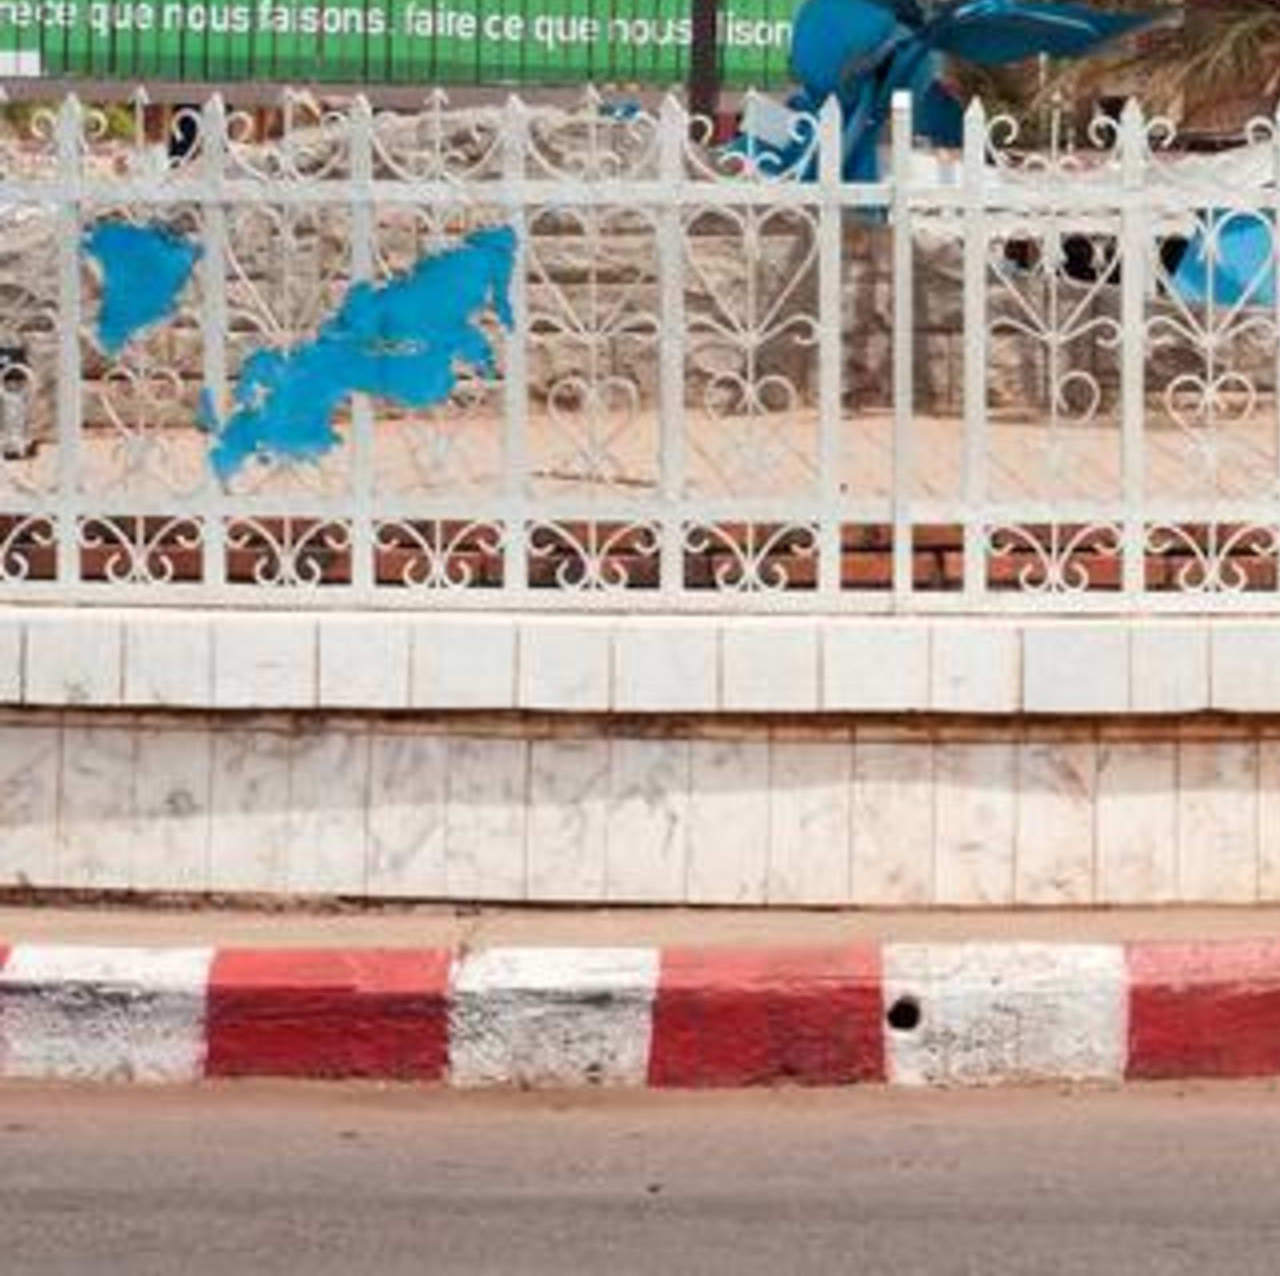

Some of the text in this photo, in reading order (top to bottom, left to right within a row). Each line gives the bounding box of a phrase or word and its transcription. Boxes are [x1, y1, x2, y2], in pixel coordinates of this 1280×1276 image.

[90, 2, 154, 37] que
[162, 3, 250, 32] nous
[406, 1, 476, 39] faire
[483, 14, 525, 40] ce
[535, 14, 599, 51] que
[607, 14, 693, 46] nous
